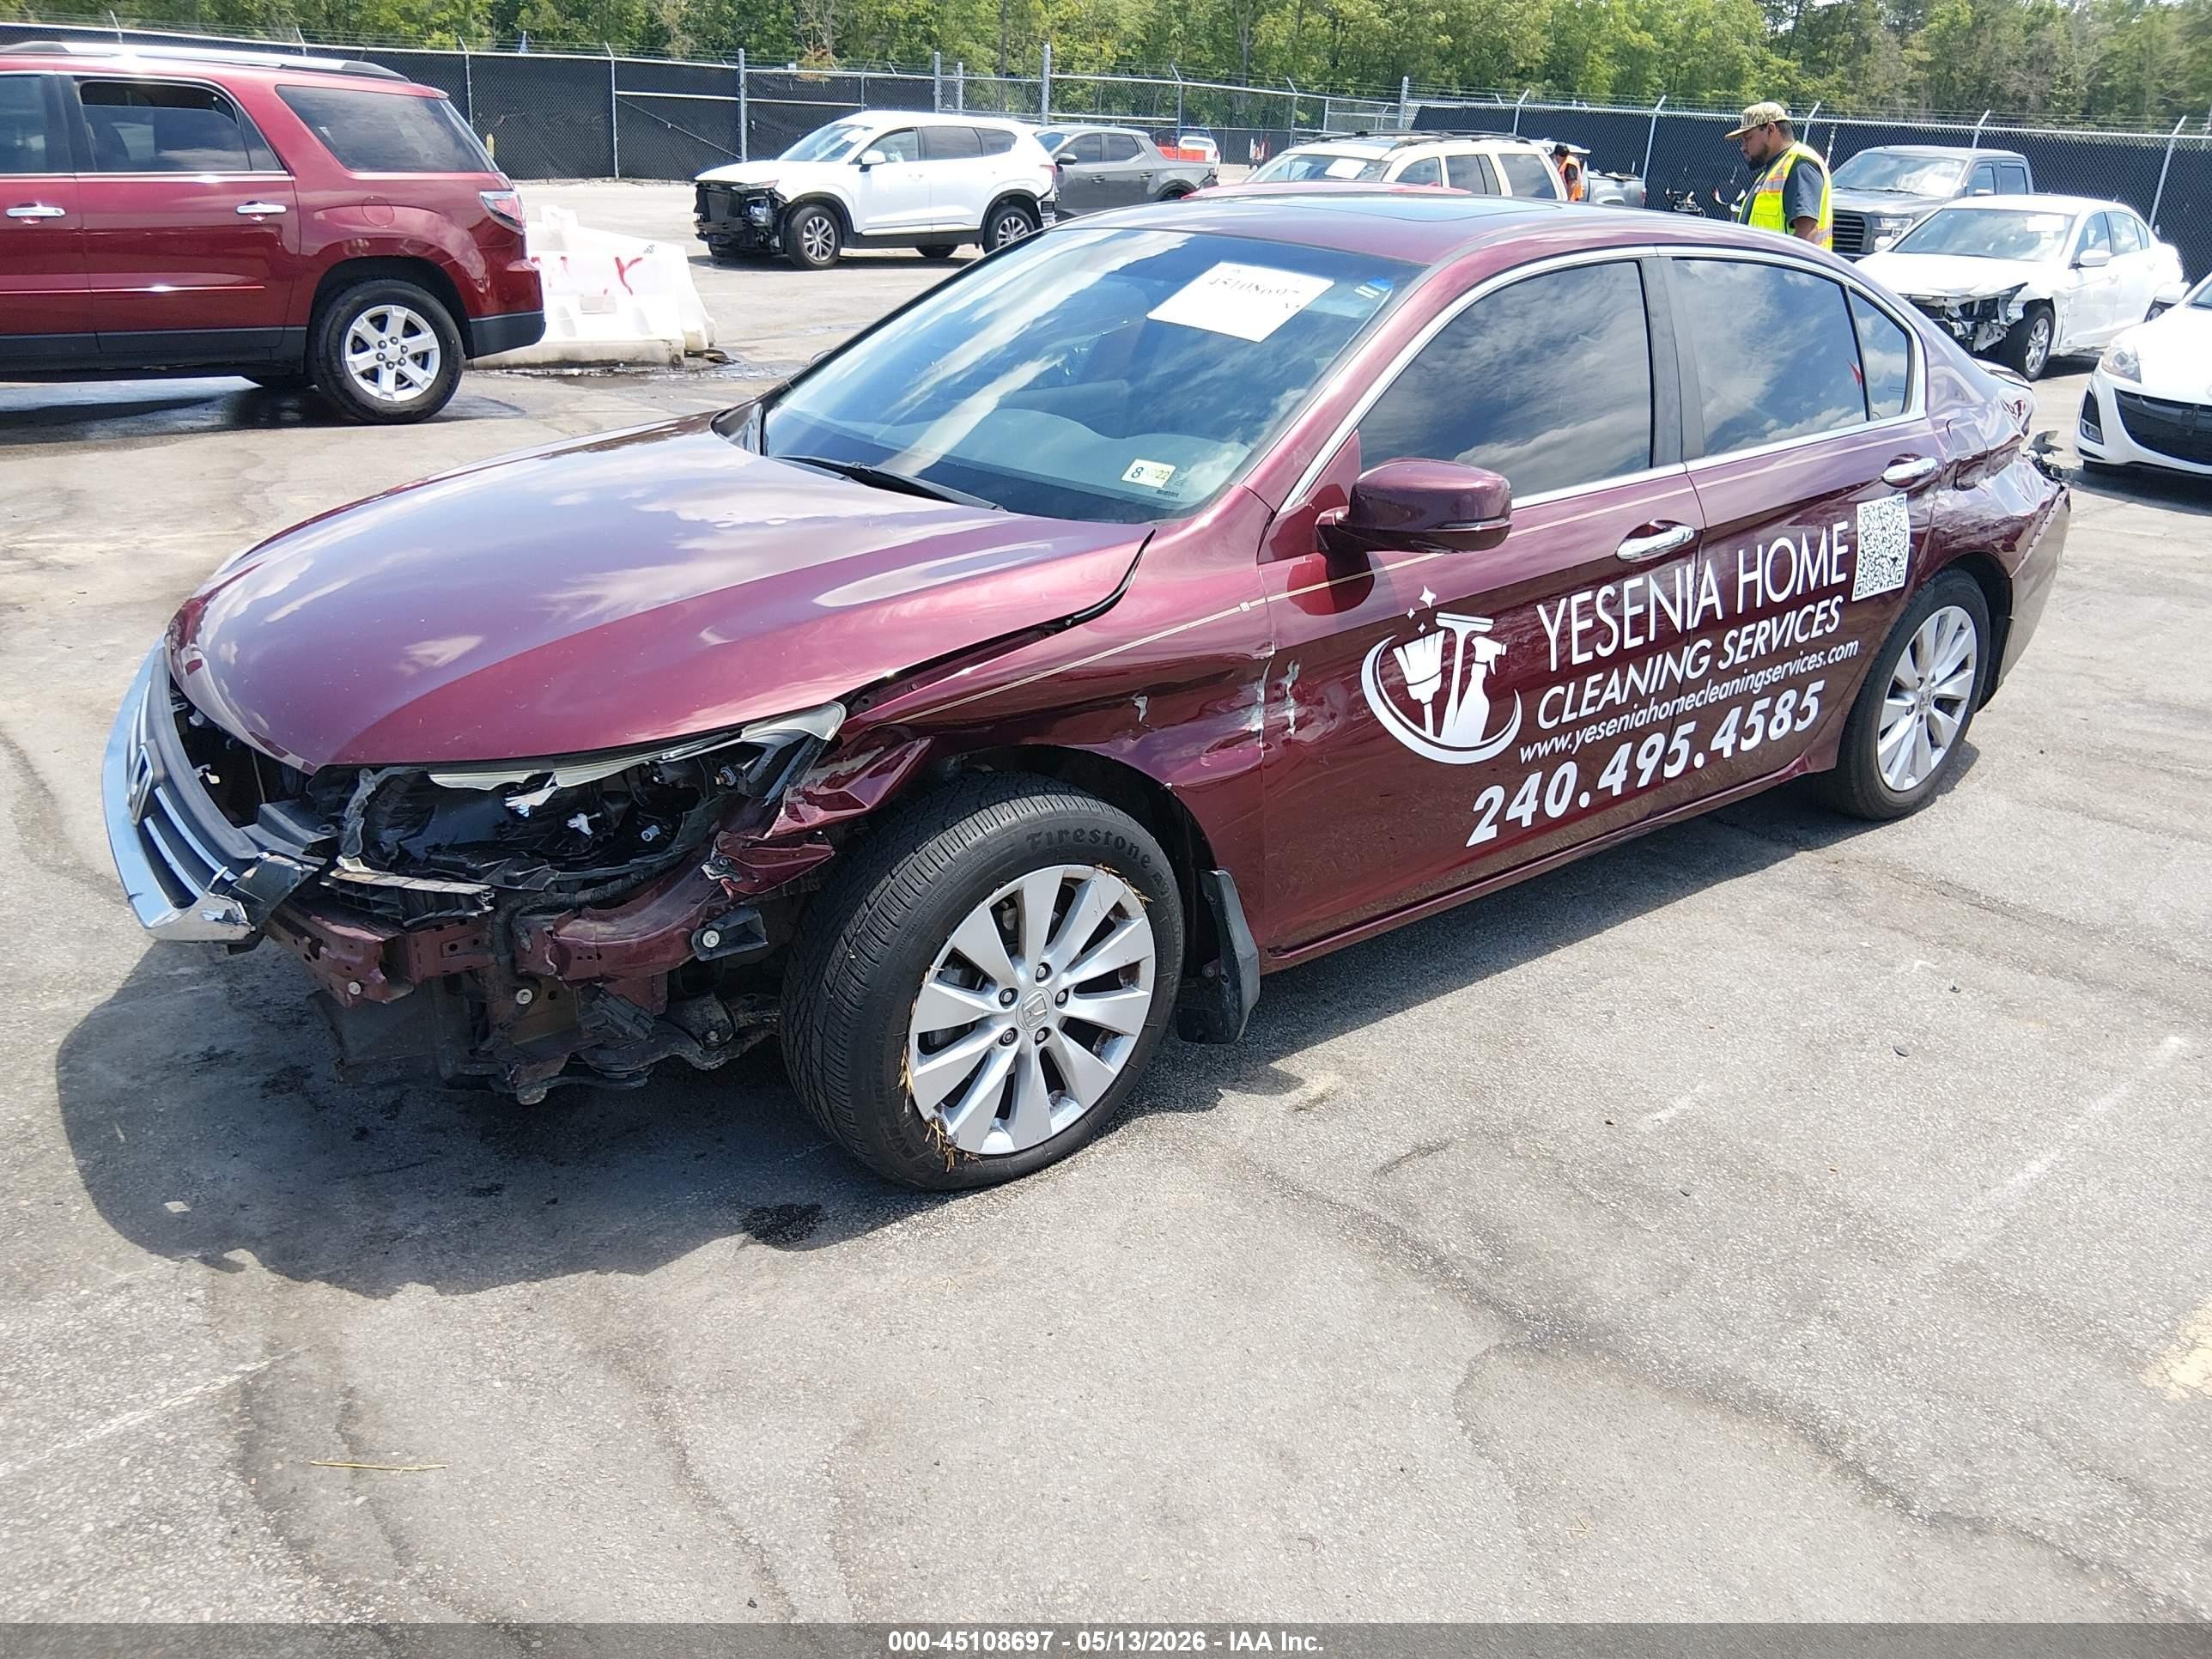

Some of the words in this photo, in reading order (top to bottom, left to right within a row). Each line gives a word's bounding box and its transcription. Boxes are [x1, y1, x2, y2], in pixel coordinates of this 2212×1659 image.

[1130, 465, 1145, 479] 8
[1536, 559, 1723, 672] YESENIA
[1737, 520, 1850, 614] HOME
[1537, 639, 1712, 730] CLEANING
[1717, 594, 1844, 671] SERVICES
[1465, 679, 1826, 848] 240.495.4585
[1519, 637, 1859, 765] www.yeseniahomecleaningservices.com
[1025, 827, 1152, 869] Firestone
